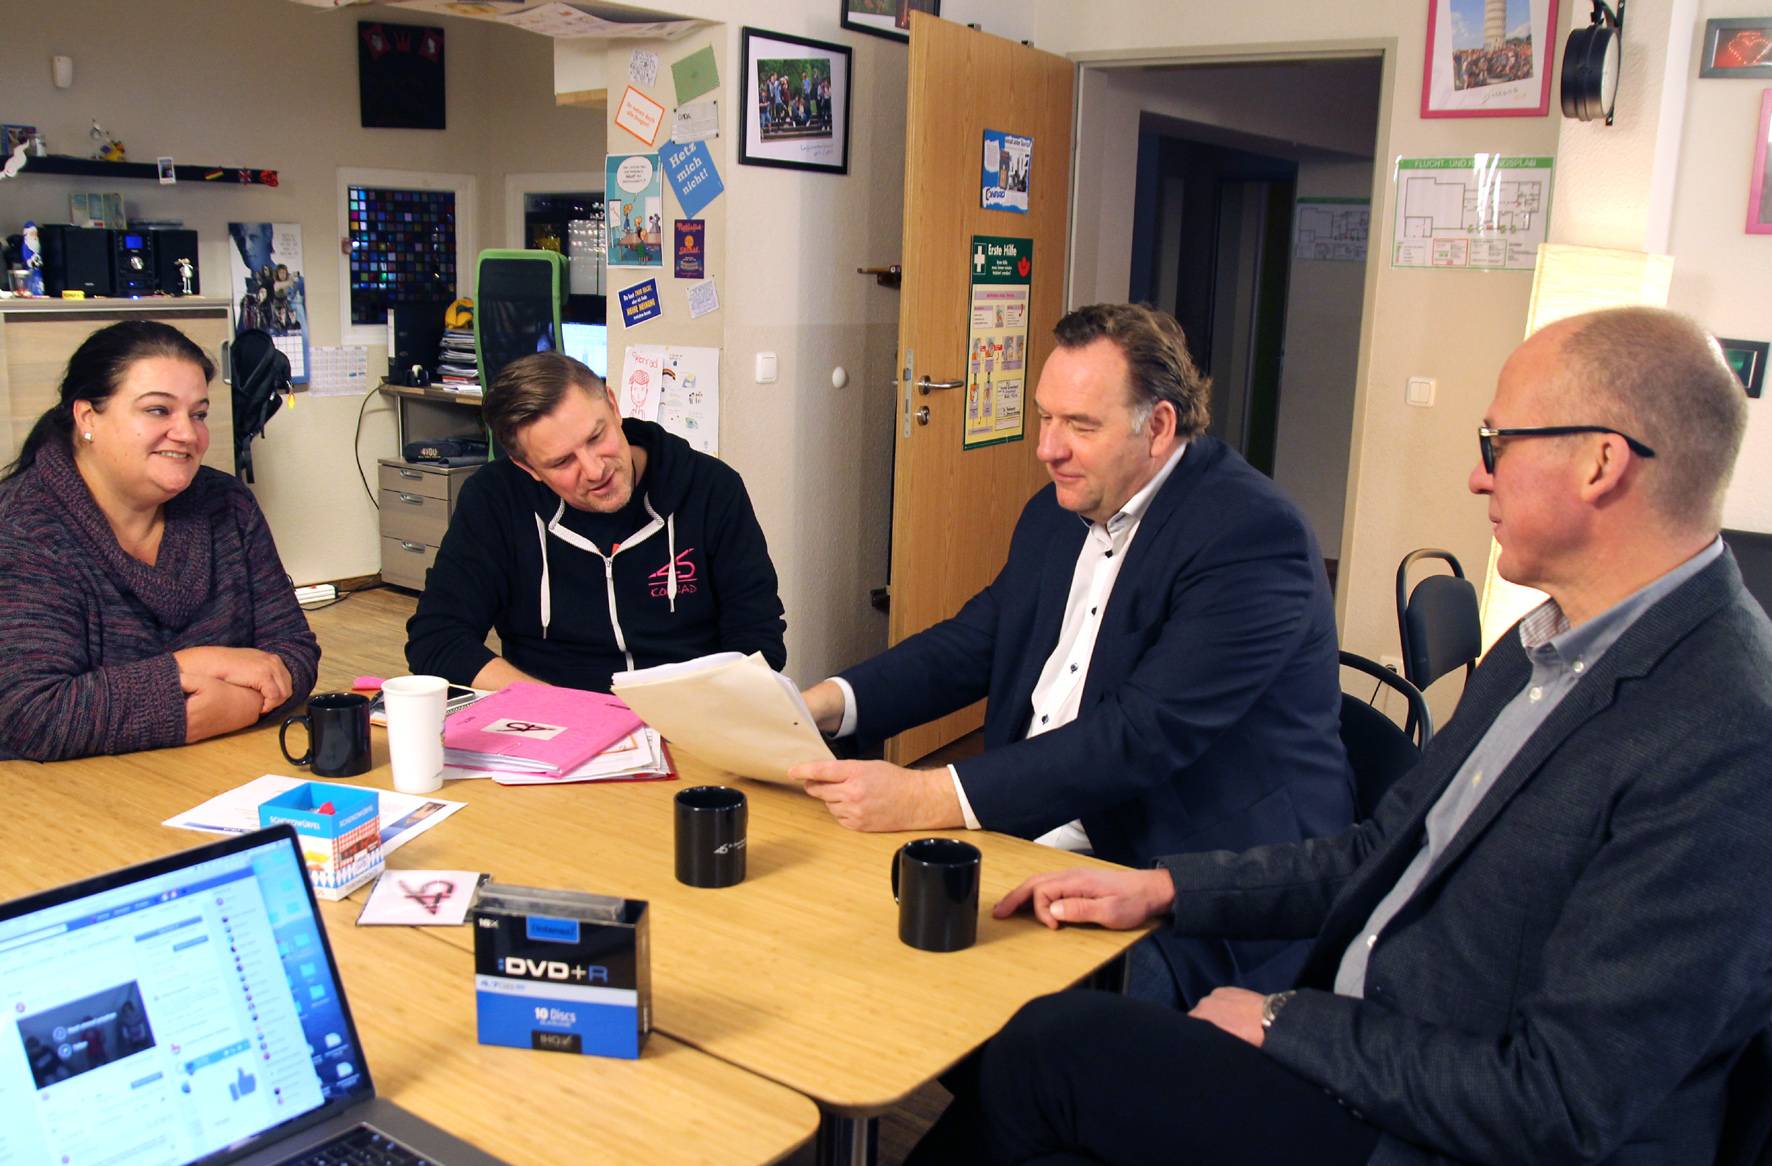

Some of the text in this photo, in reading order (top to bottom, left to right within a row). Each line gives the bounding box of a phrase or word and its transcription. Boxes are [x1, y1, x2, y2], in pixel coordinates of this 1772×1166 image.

[677, 156, 702, 182] mich
[1448, 159, 1469, 169] UND
[682, 167, 709, 195] nicht!
[988, 243, 1017, 257] Erste Hilfe
[534, 1007, 576, 1024] 10 Discs
